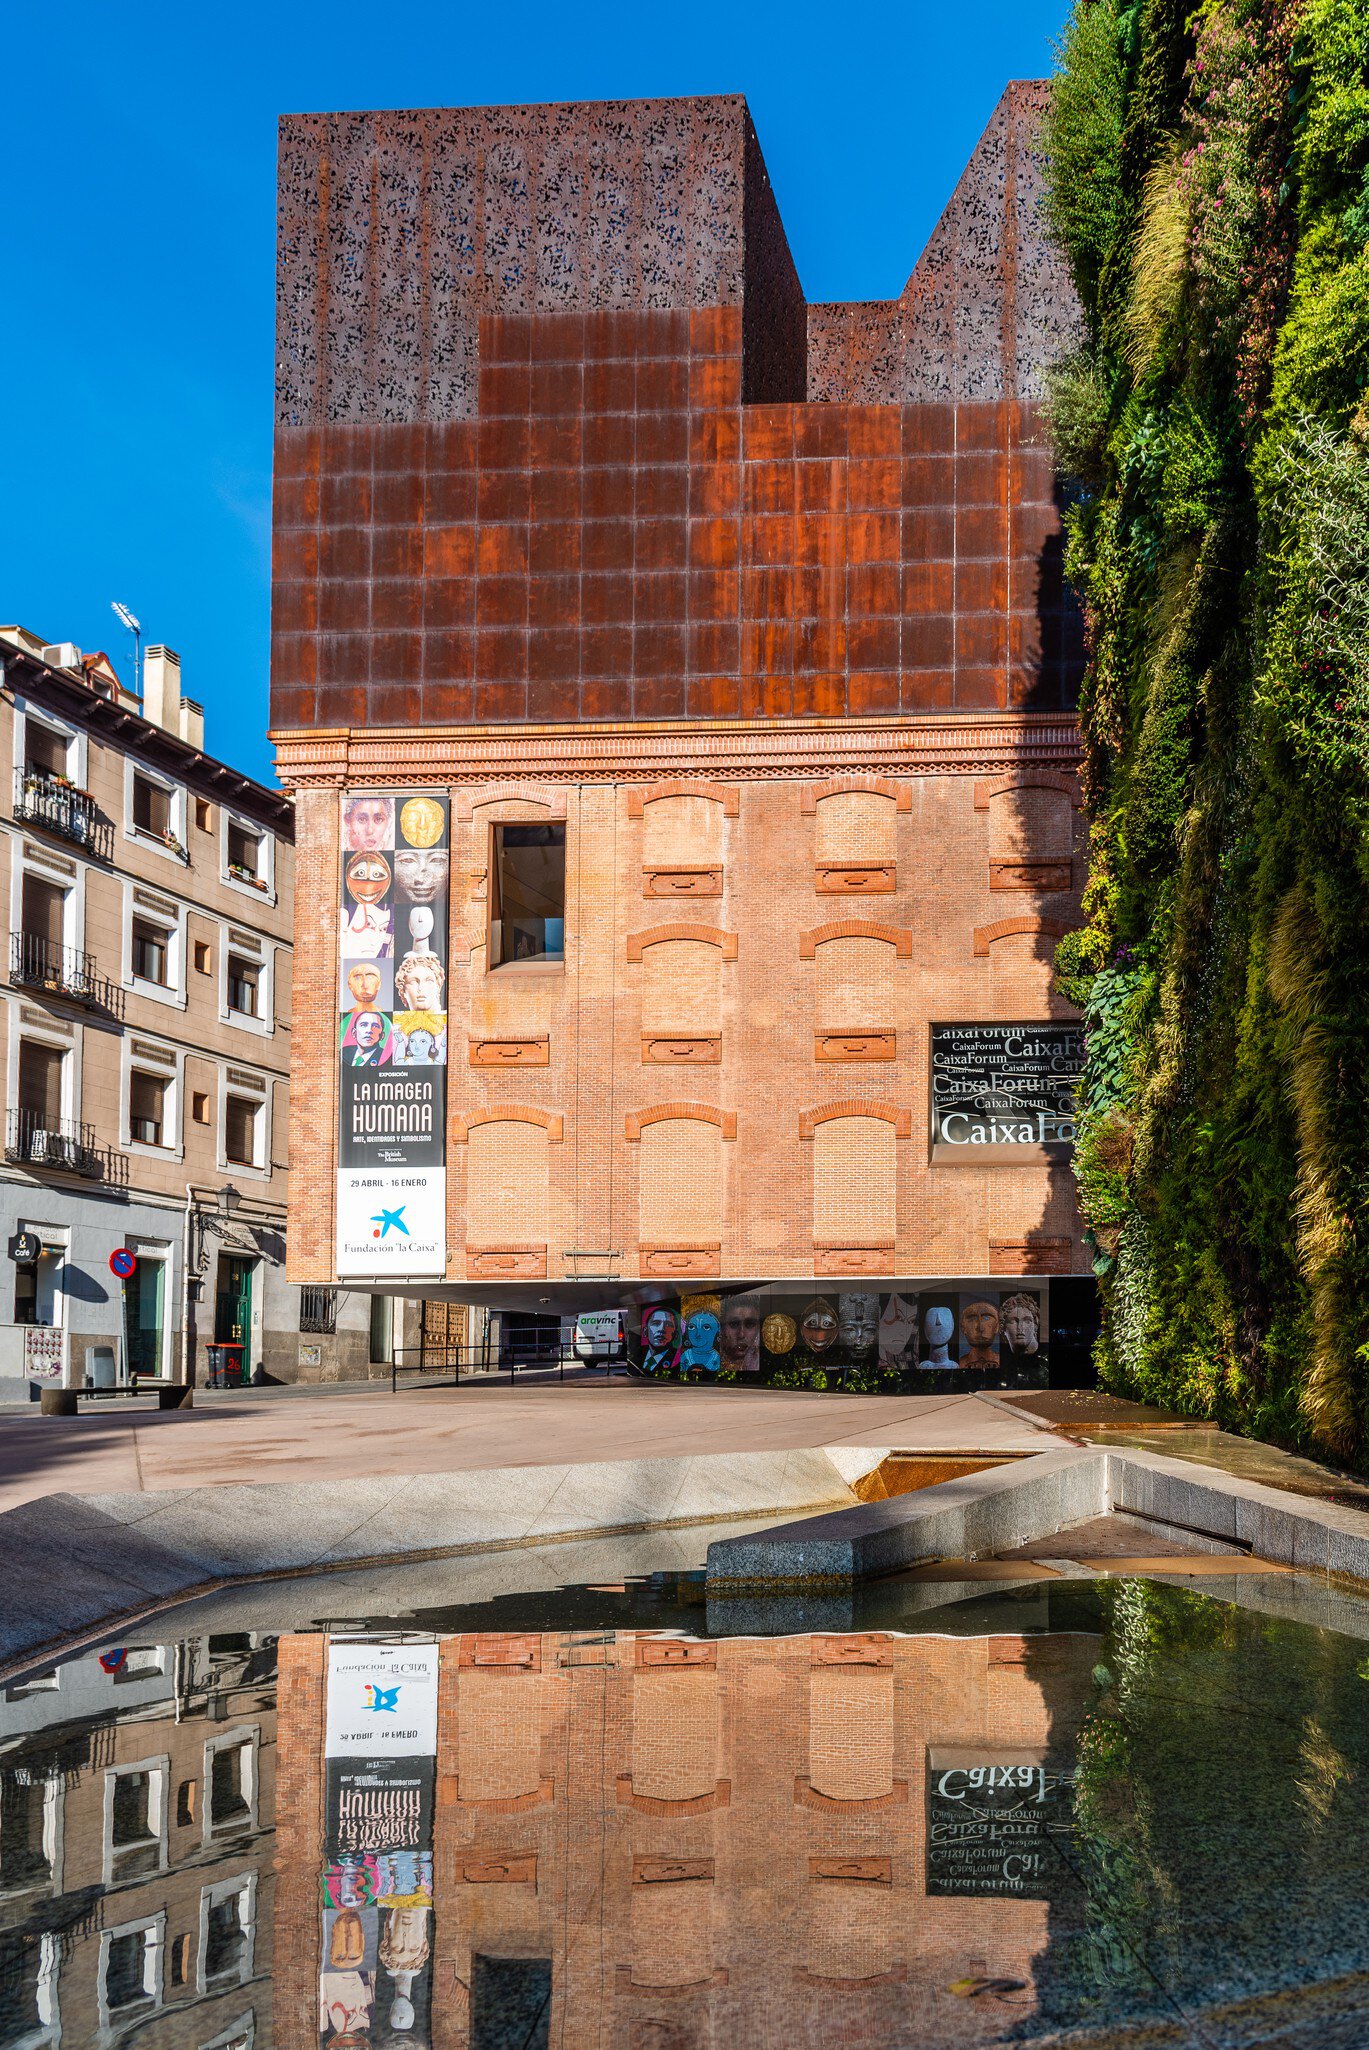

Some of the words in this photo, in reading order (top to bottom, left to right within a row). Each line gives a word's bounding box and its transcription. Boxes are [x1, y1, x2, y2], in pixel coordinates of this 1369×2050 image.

[952, 1041, 1002, 1051] CaixaForum
[933, 1051, 1007, 1065] CaixaForum
[1001, 1063, 1050, 1072] CaixaForum
[933, 1072, 1058, 1094] CaixaForum
[354, 1083, 371, 1101] LA
[375, 1082, 432, 1101] IMAGEN
[974, 1096, 1048, 1109] CaixaForum
[353, 1103, 433, 1133] HUMANA
[941, 1112, 1078, 1145] CaixaFo
[350, 1179, 360, 1188] 29
[361, 1179, 384, 1187] ABRIL
[391, 1179, 400, 1187] 16
[401, 1178, 427, 1187] ENERO
[15, 1249, 30, 1257] Café
[344, 1243, 394, 1253] Fundación
[228, 1357, 241, 1371] 26
